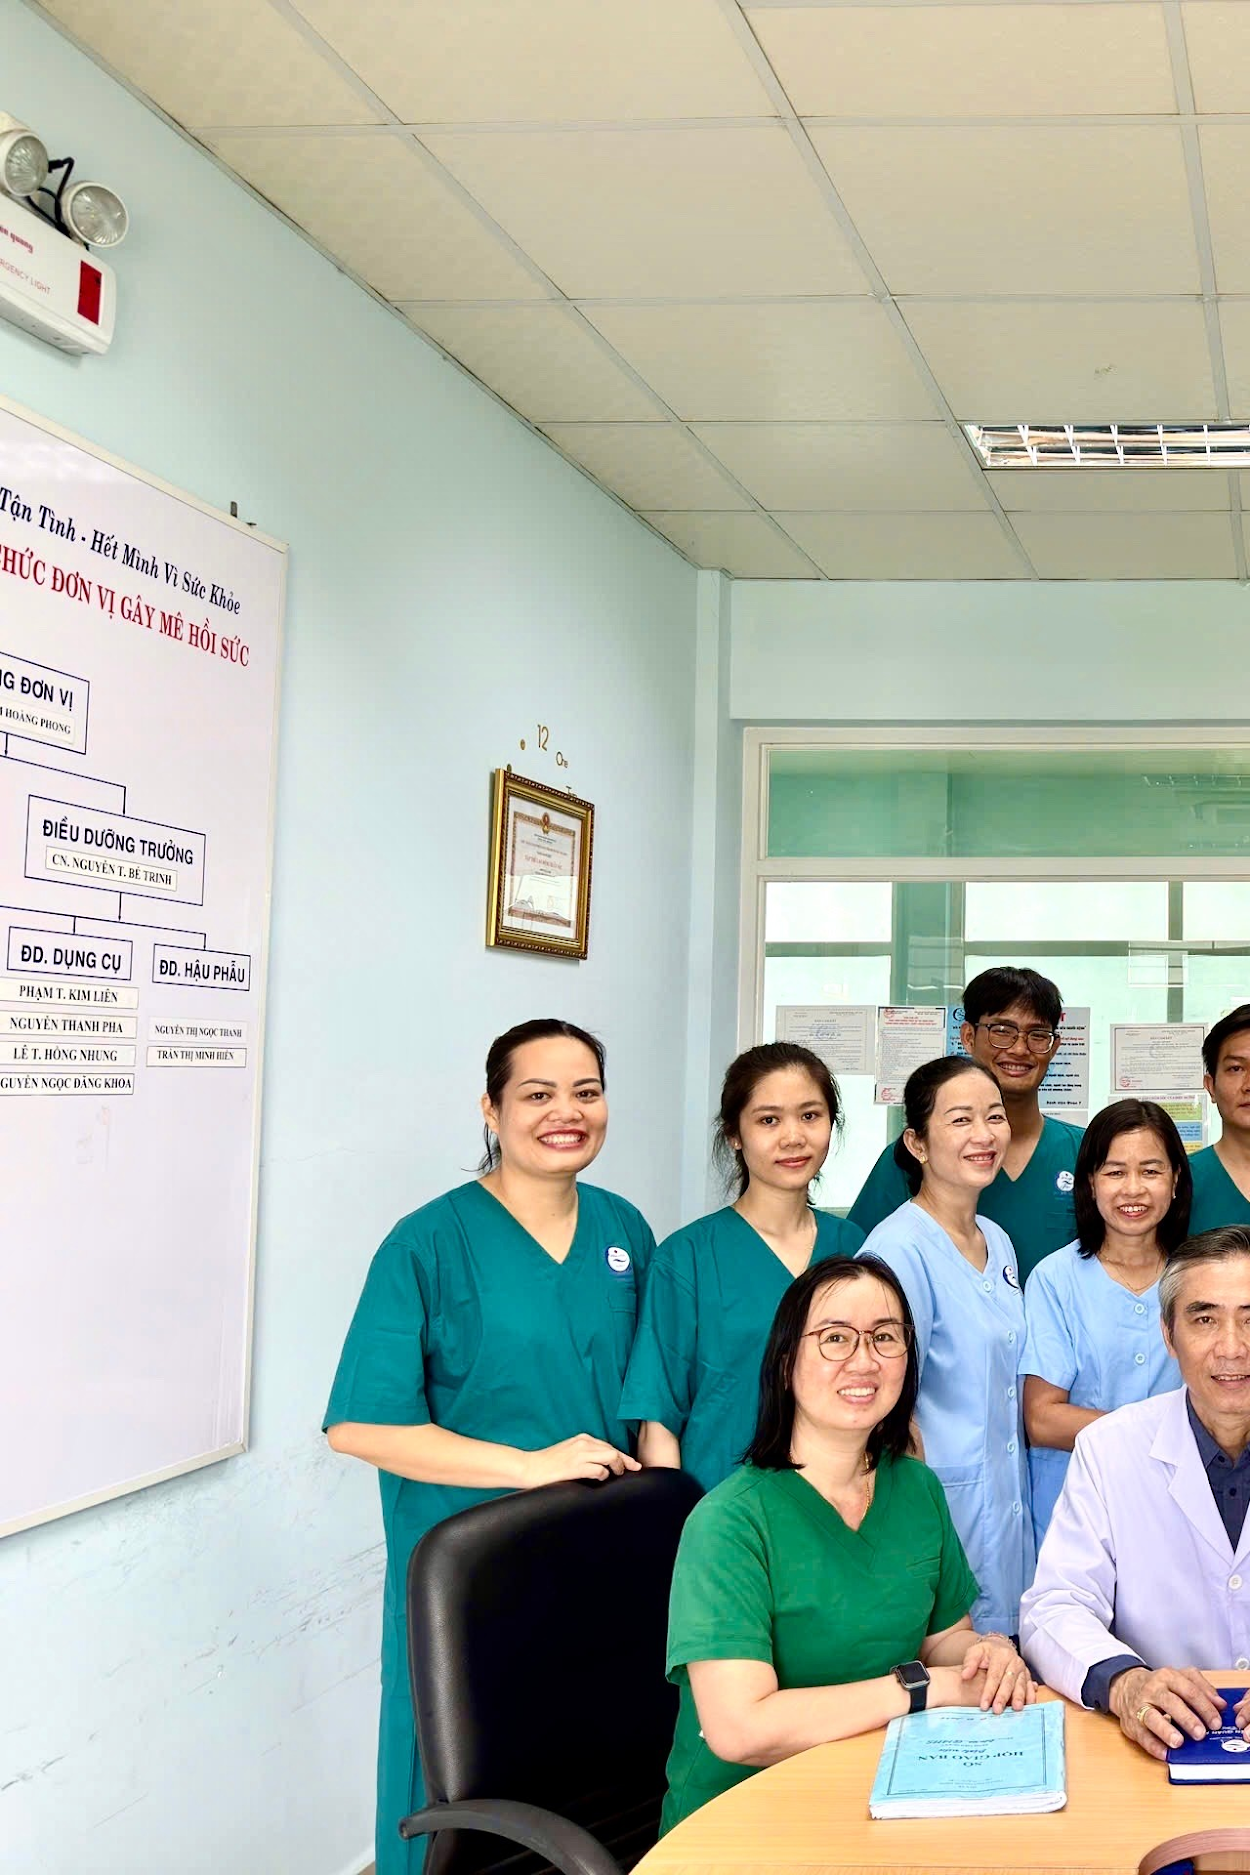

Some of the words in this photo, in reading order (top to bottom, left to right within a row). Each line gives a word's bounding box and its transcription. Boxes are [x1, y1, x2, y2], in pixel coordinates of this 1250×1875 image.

[30, 277, 50, 294] LIGHT
[0, 487, 32, 522] Tận
[38, 504, 76, 543] Tình
[90, 529, 117, 560] Hết
[122, 543, 159, 579] Mình
[164, 562, 179, 587] Vì
[183, 571, 206, 600] Sức
[209, 583, 241, 615] Khỏe
[0, 544, 45, 585] HỨC
[51, 566, 92, 604] ĐƠN
[97, 584, 115, 619] VỊ
[121, 595, 156, 630] GÂY
[159, 610, 183, 640] MÊ
[188, 617, 216, 654] HỒI
[221, 635, 249, 667] SỨC
[0, 669, 14, 690] G
[21, 676, 54, 702] ĐƠN
[60, 688, 72, 711] VỊ
[40, 718, 71, 734] PHONG
[538, 724, 548, 751] 12
[43, 816, 79, 842] ĐIỀU
[84, 828, 135, 853] DƯỠNG
[139, 839, 193, 864] TRƯỞNG
[52, 853, 70, 867] CN.
[72, 857, 115, 876] NGUYỄN
[118, 866, 127, 877] T.
[143, 871, 172, 885] TRINH
[21, 945, 47, 964] ĐD.
[54, 949, 96, 969] DỤNG
[101, 954, 122, 974] CỤ
[160, 960, 180, 976] ĐD.
[185, 959, 210, 982] HẬU
[214, 960, 244, 982] PHẪU
[19, 985, 53, 1001] PHẠM
[56, 988, 66, 1000] T.
[69, 989, 91, 1001] KIM
[93, 989, 118, 1002] LIÊN
[10, 1016, 58, 1031] NGUYỄN
[61, 1019, 99, 1032] THANH
[102, 1021, 123, 1033] PHA
[199, 1028, 218, 1038] NGỌC
[14, 1045, 28, 1060] LÊ
[31, 1048, 42, 1060] T.
[45, 1046, 77, 1061] HỒNG
[80, 1049, 118, 1062] NHUNG
[41, 1077, 72, 1091] NGỌC
[104, 1078, 131, 1089] KHOA
